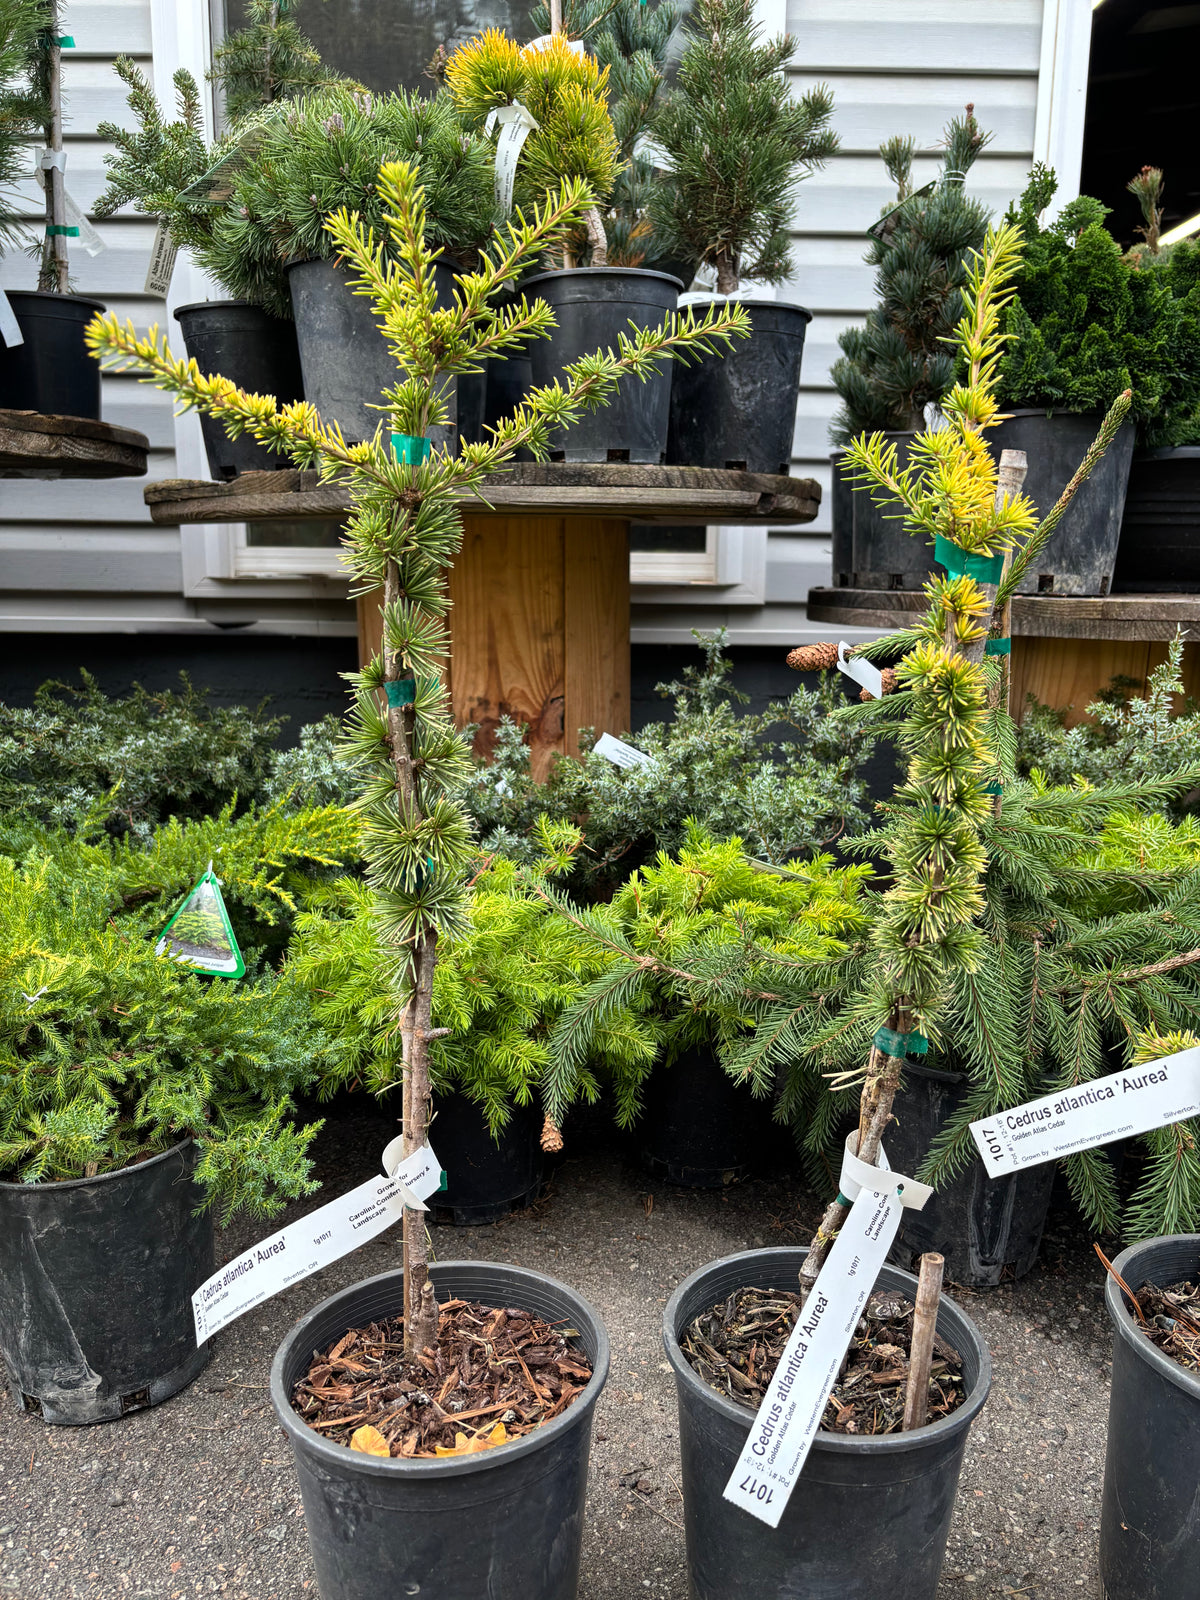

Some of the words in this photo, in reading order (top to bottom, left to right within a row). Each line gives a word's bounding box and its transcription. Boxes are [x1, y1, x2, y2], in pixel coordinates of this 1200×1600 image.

[1006, 1107, 1052, 1130] Cedrus
[1054, 1086, 1115, 1115] atlantica
[1115, 1064, 1168, 1093] 'Aurea'
[982, 1129, 1004, 1162] 1017
[1011, 1131, 1032, 1142] Golden
[1032, 1124, 1048, 1135] Atlas
[1047, 1119, 1066, 1130] Cedar
[1021, 1151, 1041, 1162] Grown
[1041, 1148, 1050, 1157] by
[348, 1205, 377, 1222] Carolina
[352, 1206, 387, 1230] Landscape
[864, 1208, 881, 1237] Carolina
[871, 1206, 891, 1241] Landscape
[202, 1280, 223, 1302] Cedrus
[223, 1259, 254, 1286] atlantica
[253, 1235, 286, 1264] 'Aurea'
[858, 1290, 866, 1302] OR
[752, 1403, 783, 1456] Cedrus
[777, 1344, 809, 1402] atlantica
[798, 1291, 829, 1339] 'Aurea'
[767, 1439, 782, 1465] Golden
[778, 1421, 789, 1440] Atlas
[785, 1401, 797, 1421] Cedar
[788, 1448, 804, 1476] Grown
[799, 1441, 807, 1451] by
[739, 1475, 774, 1505] 1017
[778, 1475, 791, 1488] Pot
